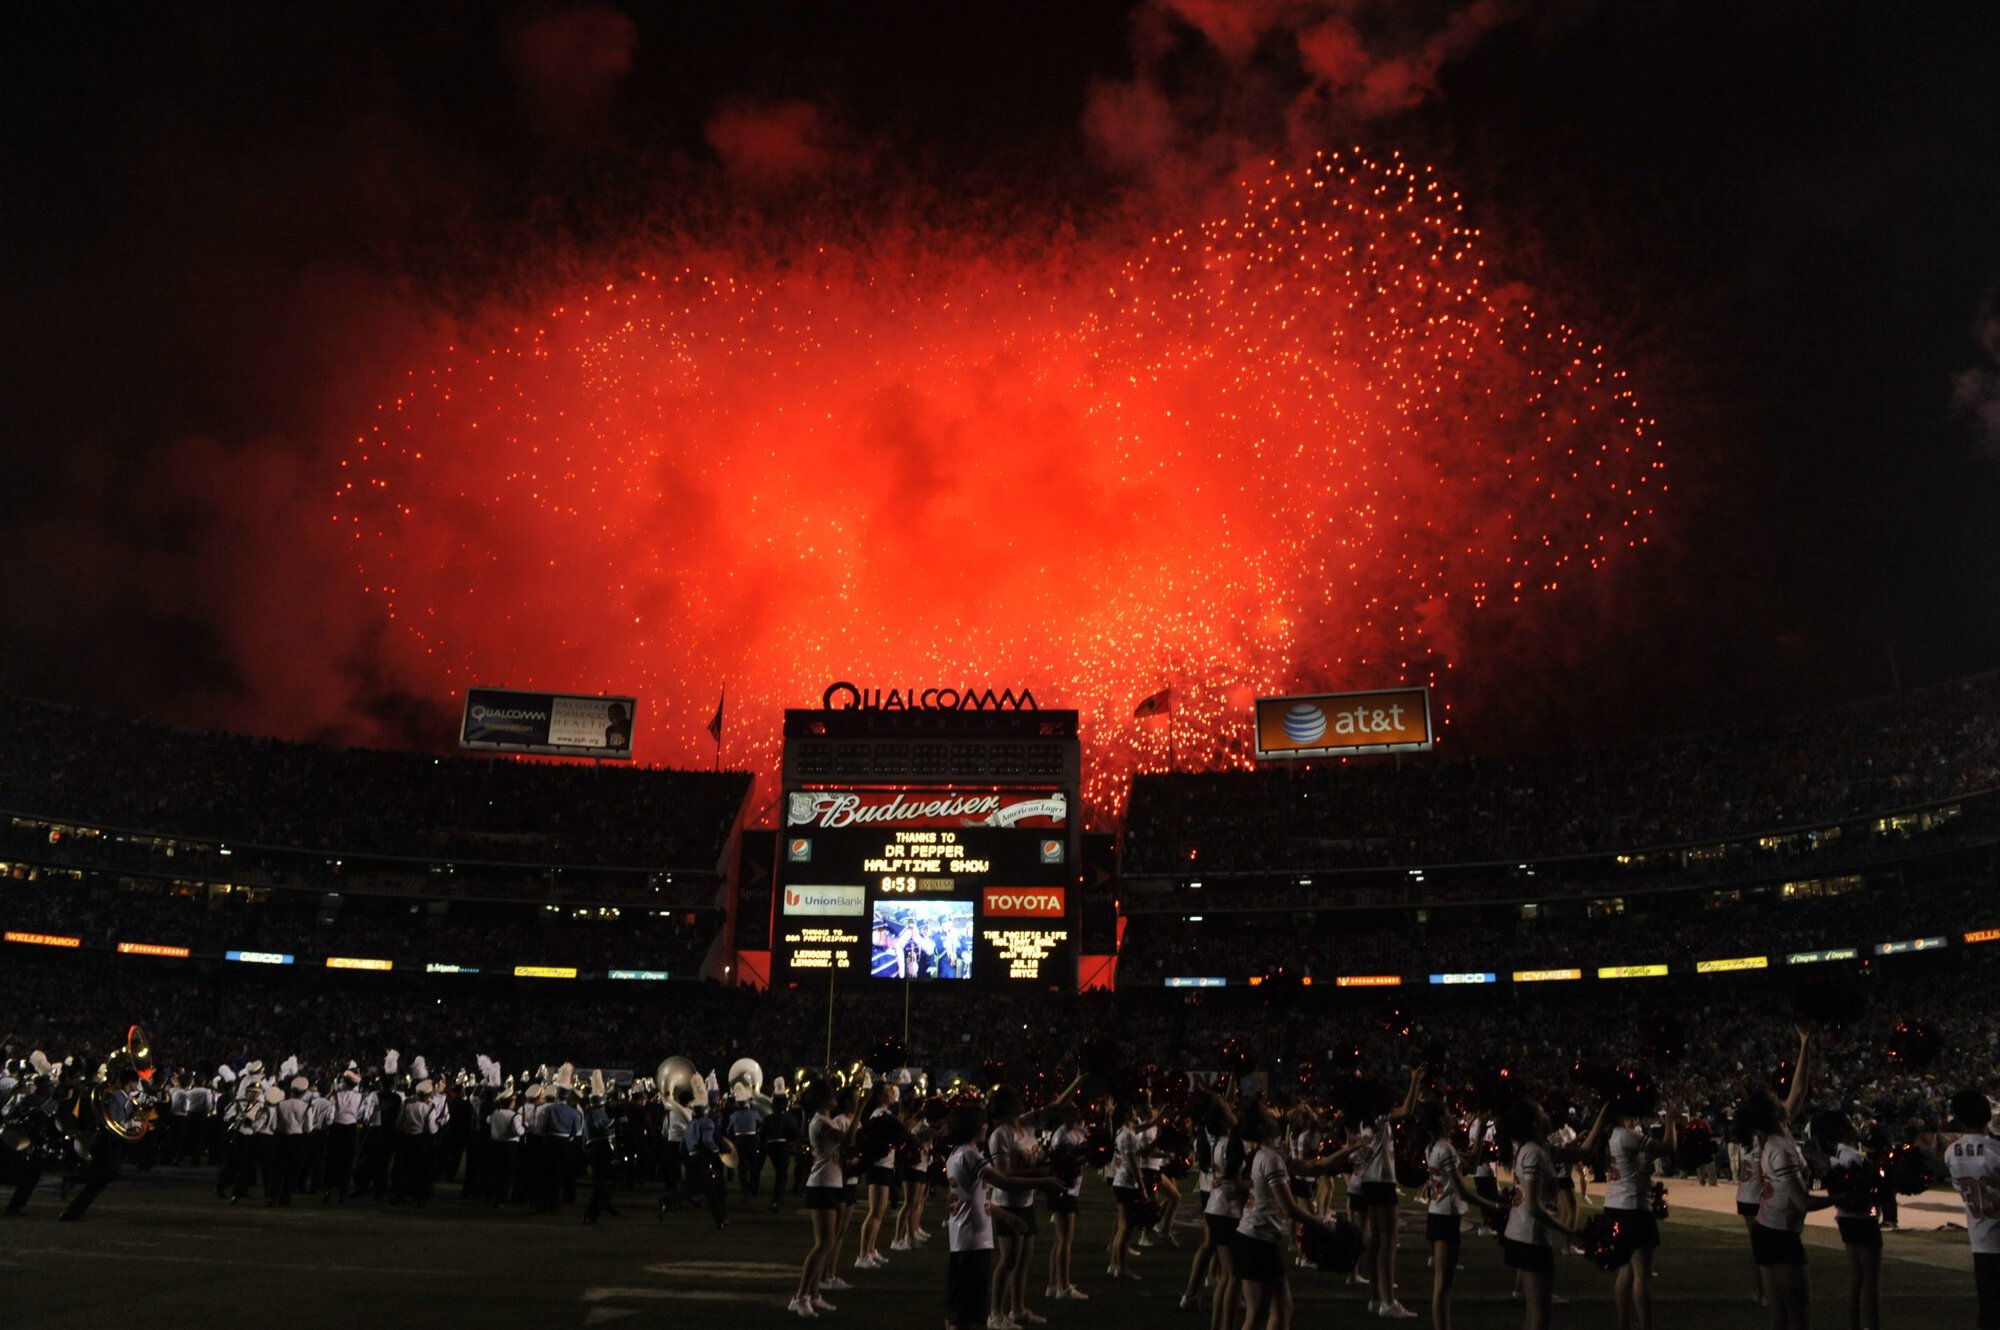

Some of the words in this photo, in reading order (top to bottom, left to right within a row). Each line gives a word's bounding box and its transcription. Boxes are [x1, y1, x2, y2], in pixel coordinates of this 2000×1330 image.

[823, 682, 1039, 710] QUALCOMM
[471, 705, 546, 721] QUALCOMM
[1335, 704, 1405, 734] at&t
[813, 793, 999, 828] Budweiser
[1002, 805, 1039, 821] American
[1040, 803, 1064, 813] Lager
[896, 833, 937, 843] THANKS
[941, 833, 955, 843] TO
[885, 845, 905, 858] DR
[911, 845, 964, 858] PEPPER
[864, 860, 941, 872] HALFTIME
[950, 860, 989, 872] SHOW
[805, 896, 862, 906] UnionBank
[987, 895, 1061, 910] TOYOTA
[833, 929, 843, 937] TO
[983, 931, 1000, 939] THE
[1003, 931, 1041, 940] PACIFIC
[1044, 931, 1067, 940] LIFE
[7, 932, 43, 943] WELLS
[44, 935, 79, 947] FARGO
[239, 951, 284, 963] GEICO
[333, 957, 386, 969] CYMER
[1443, 973, 1485, 984] GEICO
[1522, 970, 1571, 980] CYMER
